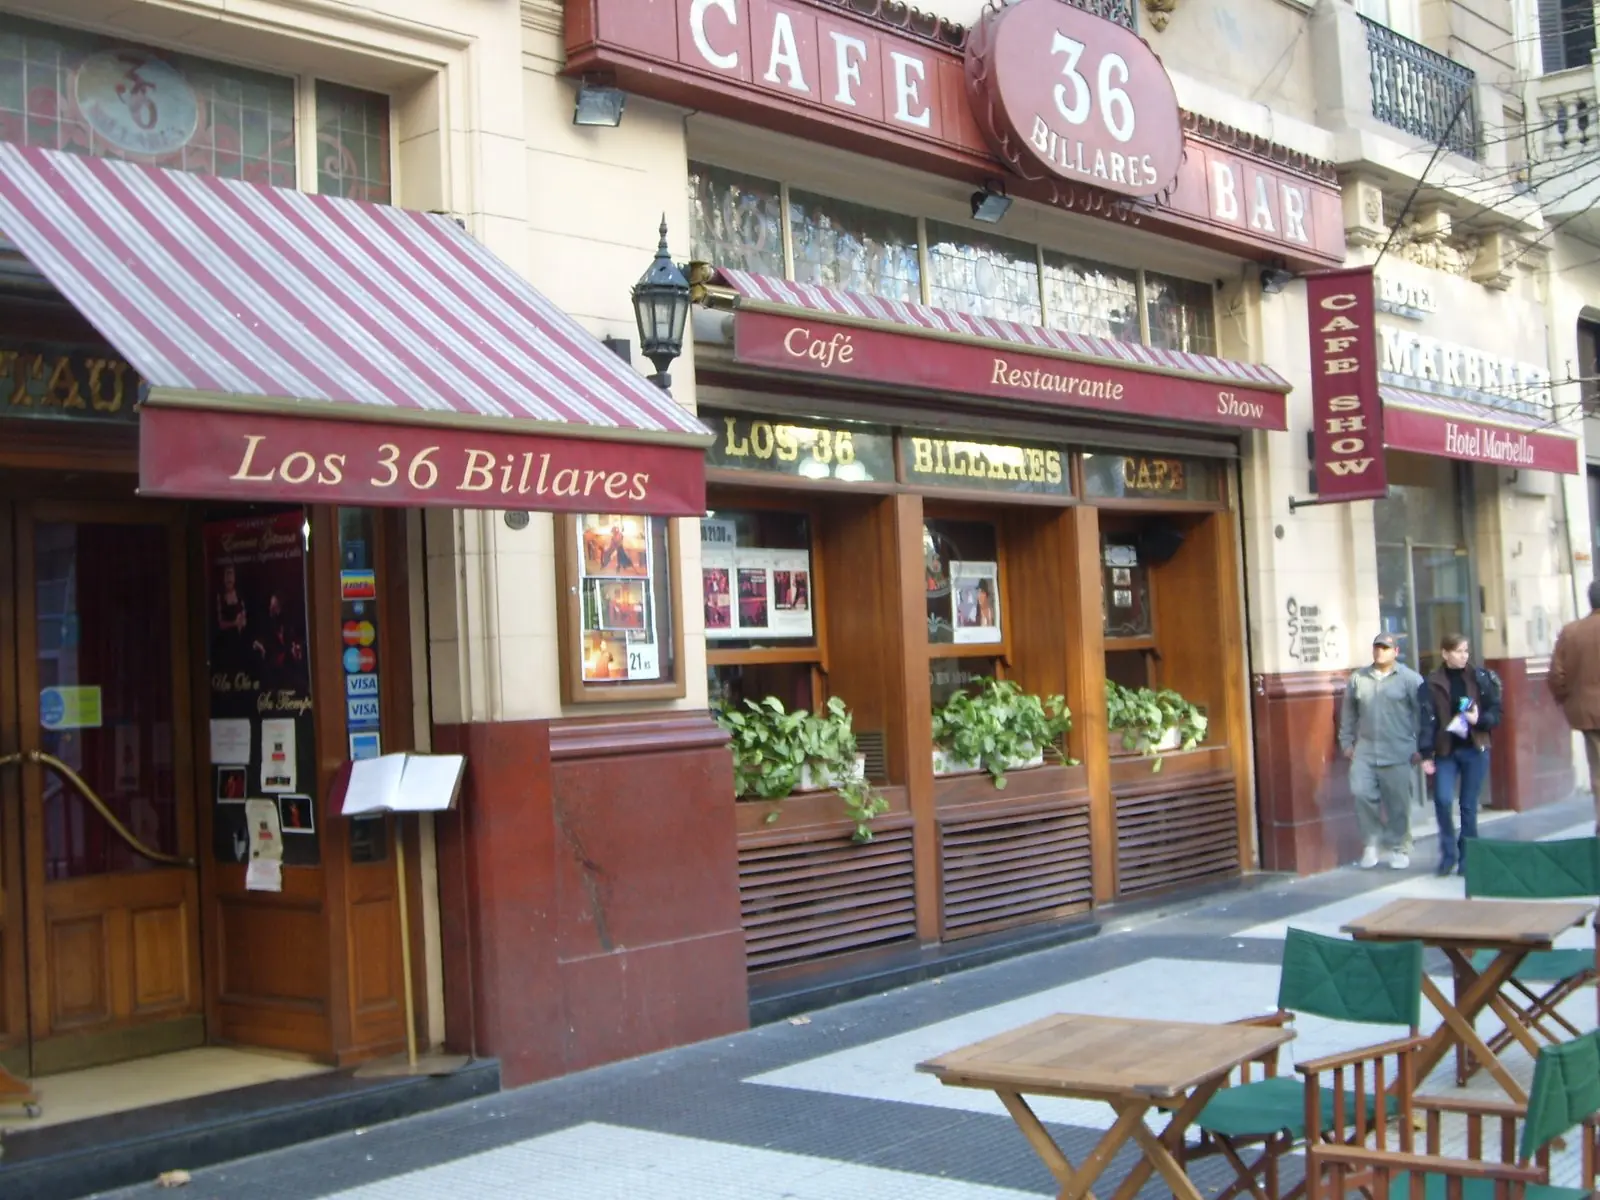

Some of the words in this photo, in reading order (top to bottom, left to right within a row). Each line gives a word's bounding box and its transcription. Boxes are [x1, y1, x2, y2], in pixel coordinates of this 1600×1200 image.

[689, 0, 932, 128] CAFE
[1050, 27, 1136, 143] 36
[1029, 114, 1158, 188] BILLARES
[1212, 160, 1310, 244] BAR
[783, 327, 854, 368] Café
[1319, 294, 1360, 376] CAFE
[991, 358, 1124, 401] Restaurante
[1217, 391, 1264, 419] Show
[724, 416, 798, 462] LOS
[811, 428, 856, 466] 36
[1323, 395, 1375, 477] SHOW
[1445, 422, 1480, 457] Hotel
[1482, 428, 1535, 464] Marbella
[229, 434, 347, 485] Los
[370, 443, 440, 490] 36
[455, 448, 650, 501] Billares
[911, 437, 1062, 485] BILLARES
[1122, 456, 1185, 491] CAFE
[350, 677, 377, 690] VISA
[629, 652, 642, 671] 21
[351, 703, 378, 716] VISA
